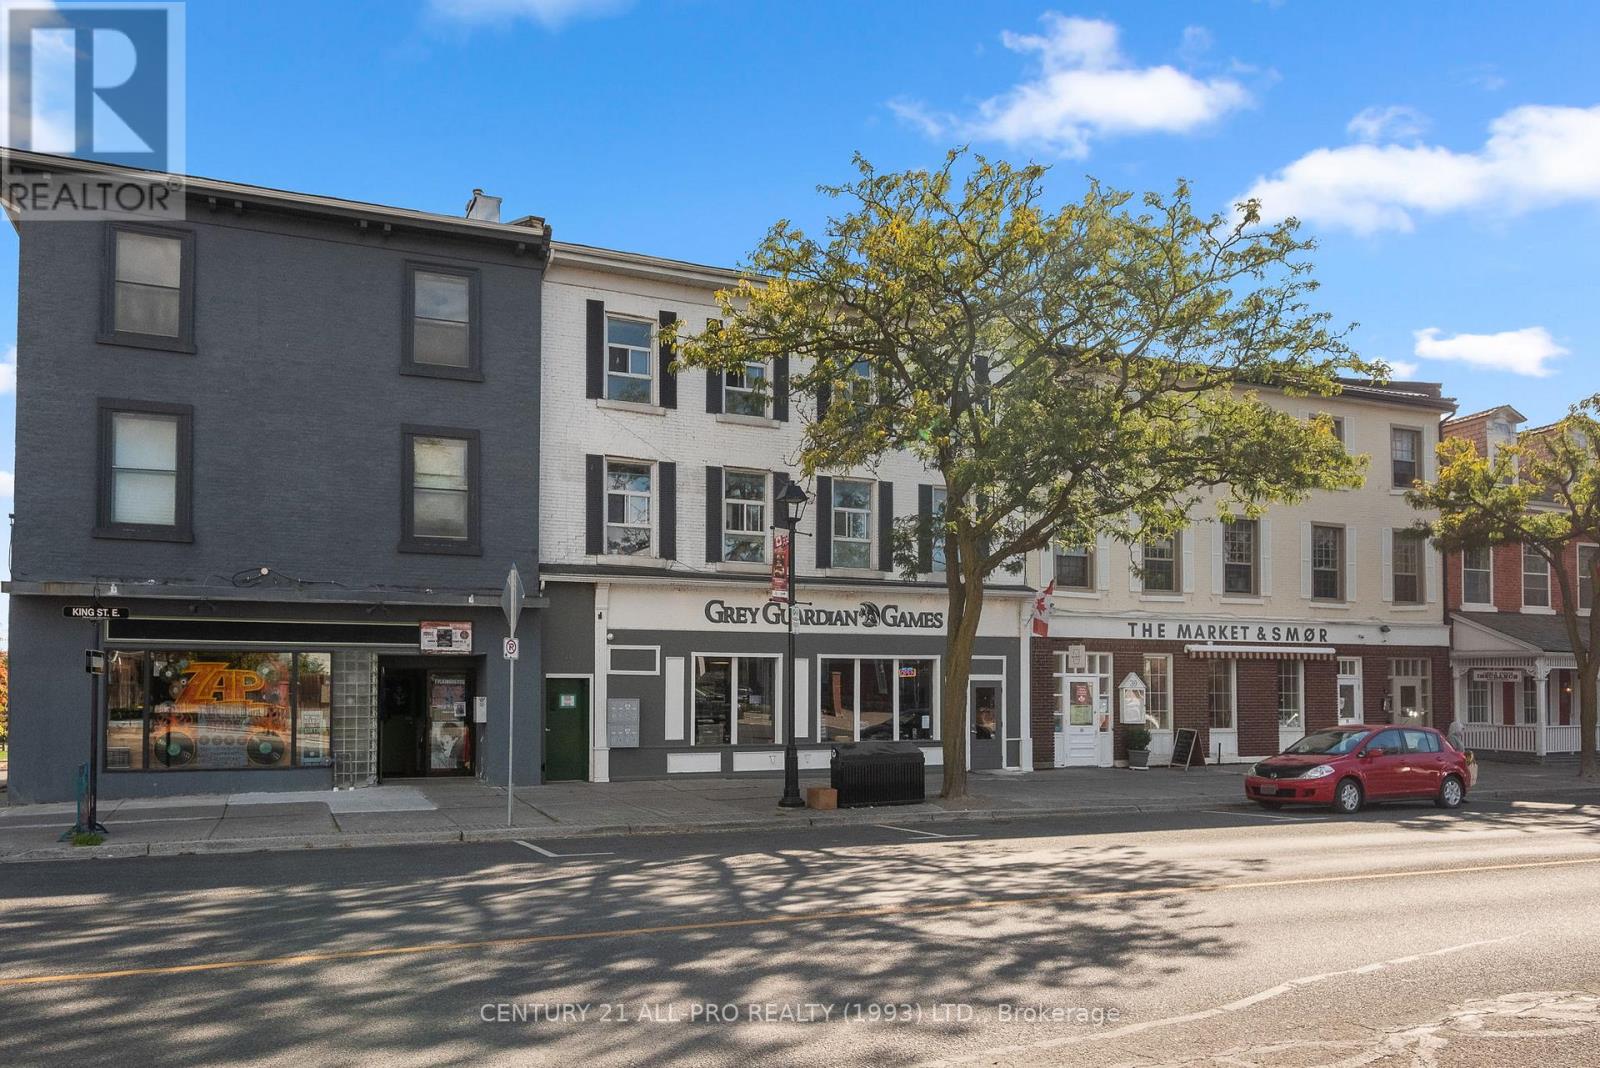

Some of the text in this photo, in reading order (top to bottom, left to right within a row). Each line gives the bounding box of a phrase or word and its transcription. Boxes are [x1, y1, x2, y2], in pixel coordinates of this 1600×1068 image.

[72, 607, 121, 617] KING ST. E.
[704, 600, 760, 624] GREY
[881, 605, 944, 629] GAMES
[1127, 622, 1166, 639] THE
[1177, 624, 1250, 641] MARKET
[1257, 625, 1267, 641] &
[175, 661, 267, 705] ZAP
